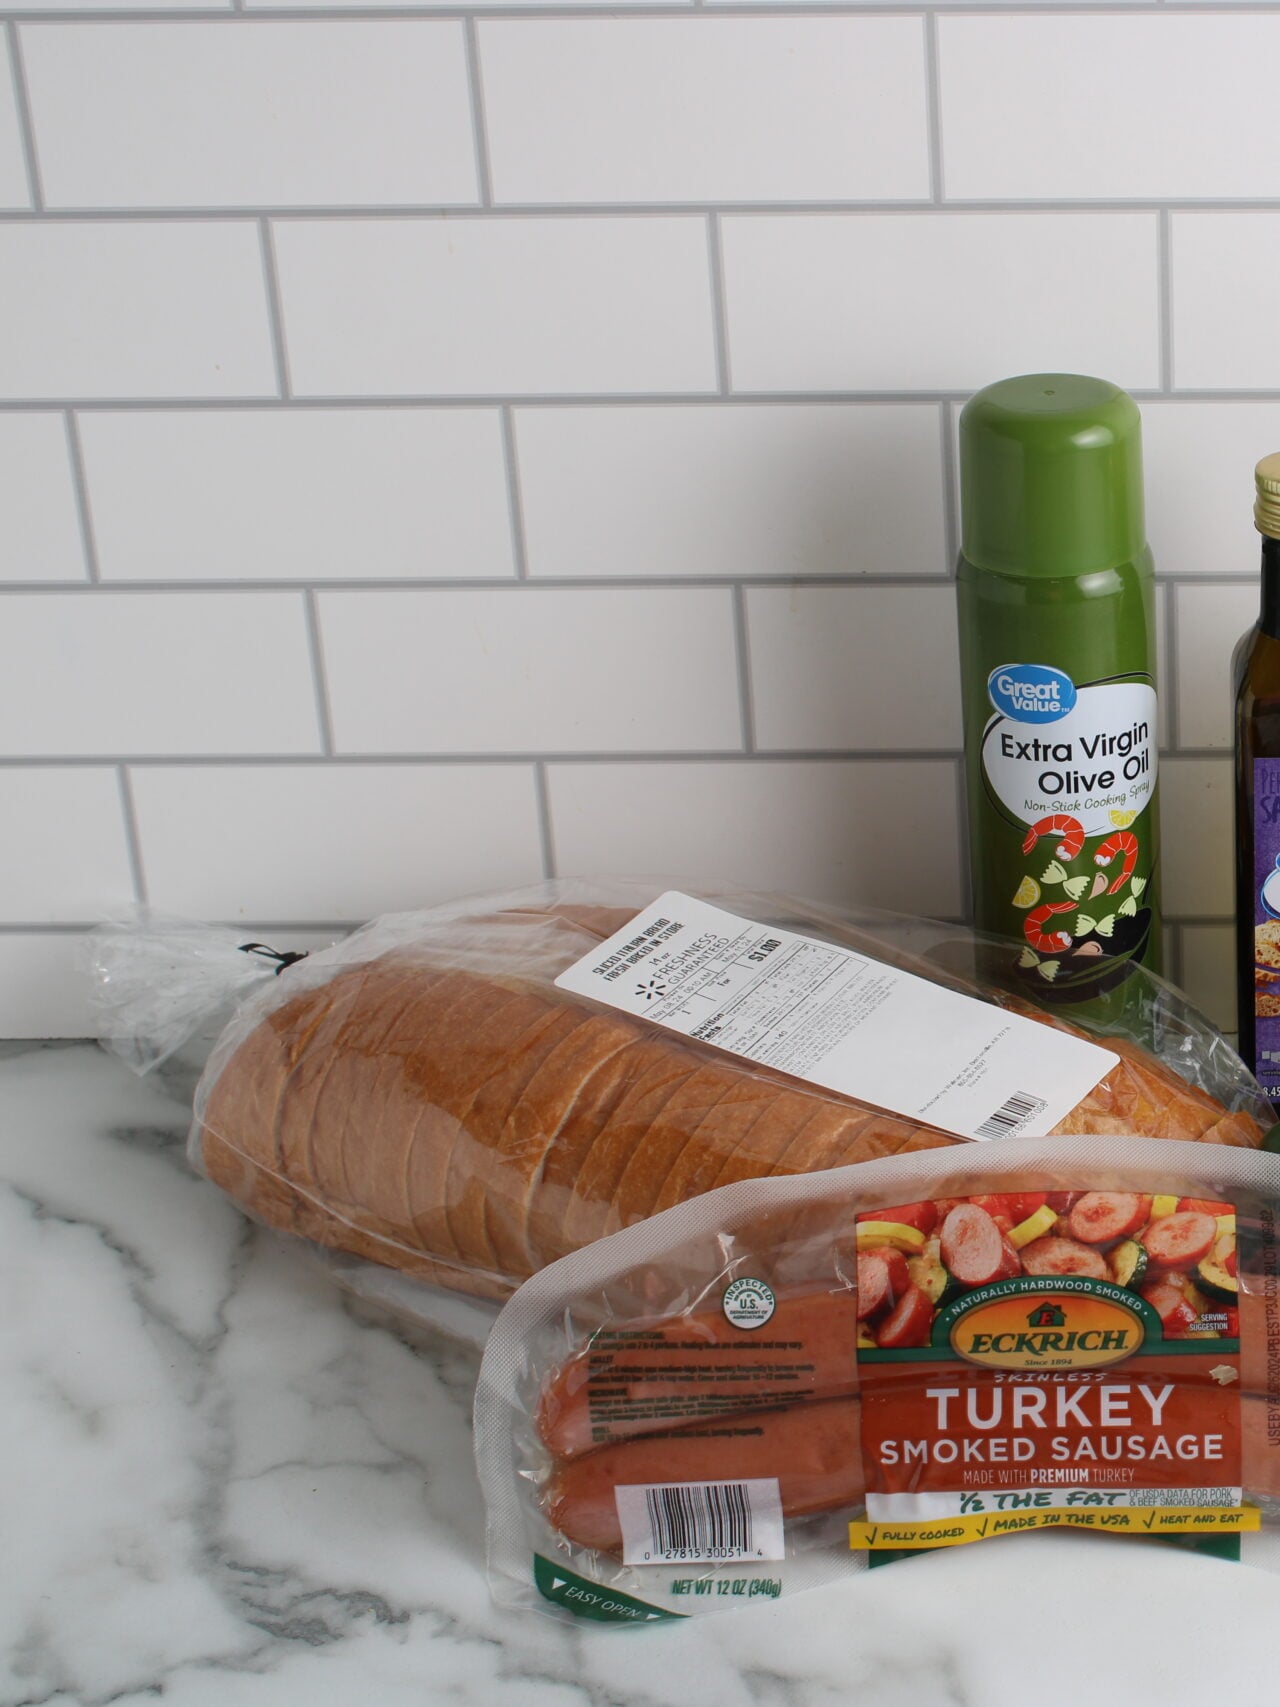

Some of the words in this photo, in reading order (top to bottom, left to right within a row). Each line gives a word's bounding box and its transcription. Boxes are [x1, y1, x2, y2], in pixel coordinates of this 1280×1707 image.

[997, 675, 1060, 700] Great
[1012, 696, 1061, 712] Value
[1001, 734, 1072, 762] Extra
[1080, 721, 1148, 760] Virgin
[1038, 770, 1115, 795] Olive
[1123, 749, 1149, 780] Oil
[1024, 799, 1080, 813] Non-Stick
[1084, 790, 1127, 810] Cooking
[1129, 780, 1150, 801] Spray
[592, 955, 621, 975] SLICED
[616, 935, 648, 957] ITALIAN
[642, 918, 671, 937] BREAD
[603, 963, 631, 981] FRESH
[626, 945, 654, 964] BAKED
[649, 939, 663, 949] IN
[658, 922, 686, 941] STORE
[652, 932, 718, 980] FRESHNESS
[748, 938, 782, 962] $1.00
[649, 958, 662, 966] 14
[667, 937, 730, 984] GUARANTEED
[690, 1013, 725, 1037] Nutrition
[726, 1280, 773, 1301] INSPECTED
[951, 1283, 1016, 1316] NATURALLY
[1020, 1280, 1092, 1292] HARDWOOD
[1095, 1285, 1142, 1311] SMOKED
[740, 1299, 759, 1309] U.S.
[1037, 1310, 1054, 1326] E
[1189, 1322, 1228, 1331] SUGGESTION
[1201, 1313, 1228, 1321] SERVING
[968, 1330, 1128, 1356] ECKRICH
[1051, 1358, 1072, 1366] 1894
[994, 1372, 1108, 1383] SKINLESS
[926, 1385, 1175, 1431] TURKEY
[880, 1439, 1036, 1465] SMOKED
[1050, 1434, 1224, 1461] SAUSAGE
[963, 1470, 994, 1484] MADE
[999, 1469, 1027, 1484] WITH
[1030, 1468, 1089, 1483] PREMIUM
[1093, 1468, 1135, 1483] TURKEY
[993, 1491, 1053, 1510] THE
[1066, 1491, 1127, 1507] FAT
[1129, 1489, 1141, 1499] OF
[1143, 1489, 1164, 1498] USDA
[1168, 1489, 1189, 1498] DATA
[1192, 1488, 1208, 1498] FOR
[1210, 1488, 1232, 1499] PORK
[1138, 1498, 1158, 1507] BEEF
[1160, 1498, 1195, 1507] SMOKED
[993, 1517, 1037, 1532] MADE
[1041, 1514, 1061, 1525] IN
[1066, 1513, 1095, 1525] THE
[1101, 1515, 1130, 1526] USA
[1160, 1515, 1191, 1524] HEAT
[1193, 1515, 1216, 1523] AND
[1220, 1513, 1244, 1523] EAT
[883, 1531, 916, 1541] FULLY
[919, 1527, 965, 1540] COOKED
[644, 1552, 650, 1561] 0
[665, 1549, 701, 1559] 27815
[706, 1548, 742, 1558] 30051
[757, 1549, 763, 1557] 4
[672, 1580, 695, 1595] NET
[697, 1580, 714, 1595] WT
[716, 1580, 728, 1595] 12
[733, 1579, 746, 1594] OZ
[749, 1579, 782, 1598] (340g)
[565, 1585, 604, 1606] EASY
[601, 1599, 641, 1618] OPEN
